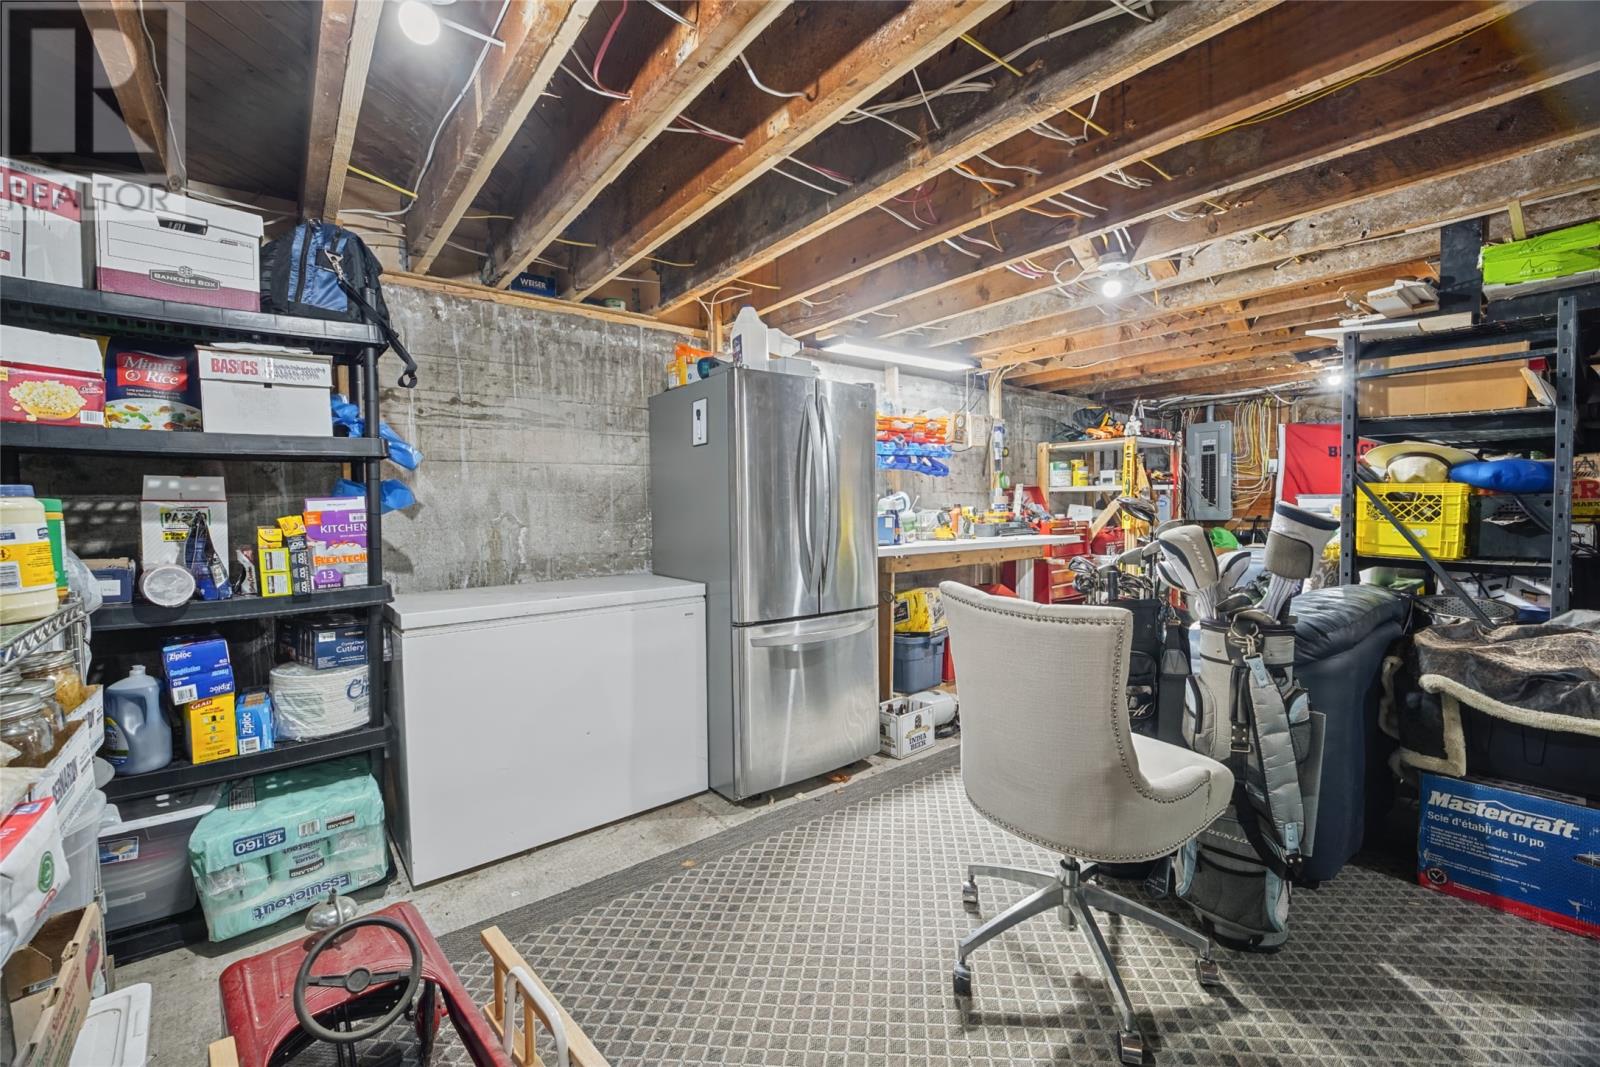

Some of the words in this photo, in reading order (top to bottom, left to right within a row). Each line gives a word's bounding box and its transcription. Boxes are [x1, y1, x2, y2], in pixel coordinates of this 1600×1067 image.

[153, 273, 196, 285] BANKERS
[198, 279, 216, 288] BOX
[520, 277, 546, 290] WEISER
[123, 355, 182, 373] Minute
[211, 357, 259, 376] BASICS
[145, 370, 179, 385] Rice
[320, 523, 367, 534] KITCHEN
[322, 570, 334, 579] 13
[168, 651, 192, 662] Ziploc
[336, 644, 364, 654] Cutlery
[242, 712, 254, 735] Ziploc
[909, 732, 927, 745] INDIA
[1427, 790, 1580, 840] Mastercraft
[1427, 810, 1449, 824] Scie
[1494, 828, 1509, 839] de
[1512, 832, 1526, 844] 10
[235, 837, 264, 854] 160
[268, 834, 284, 846] 12
